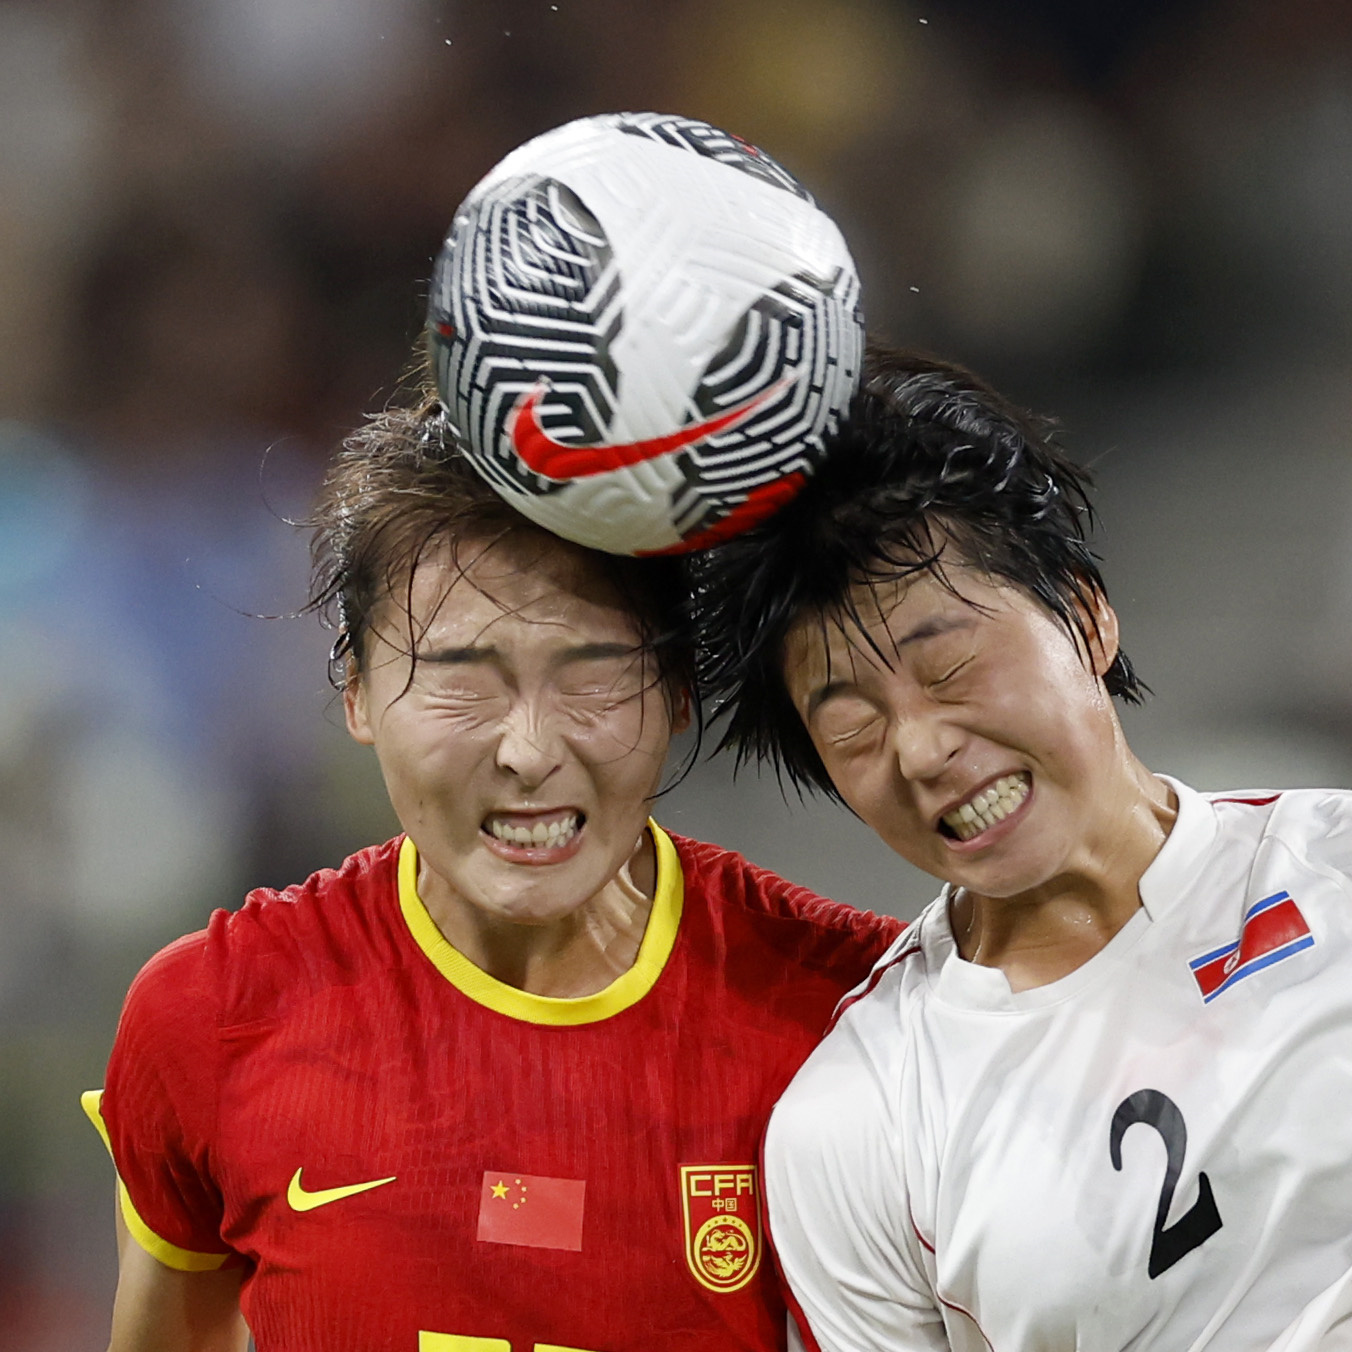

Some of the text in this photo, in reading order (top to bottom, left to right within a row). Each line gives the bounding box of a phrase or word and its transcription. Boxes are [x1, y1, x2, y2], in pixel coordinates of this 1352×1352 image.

[690, 1174, 753, 1196] CFA
[1110, 1088, 1223, 1280] 2
[711, 1198, 737, 1212] 中国
